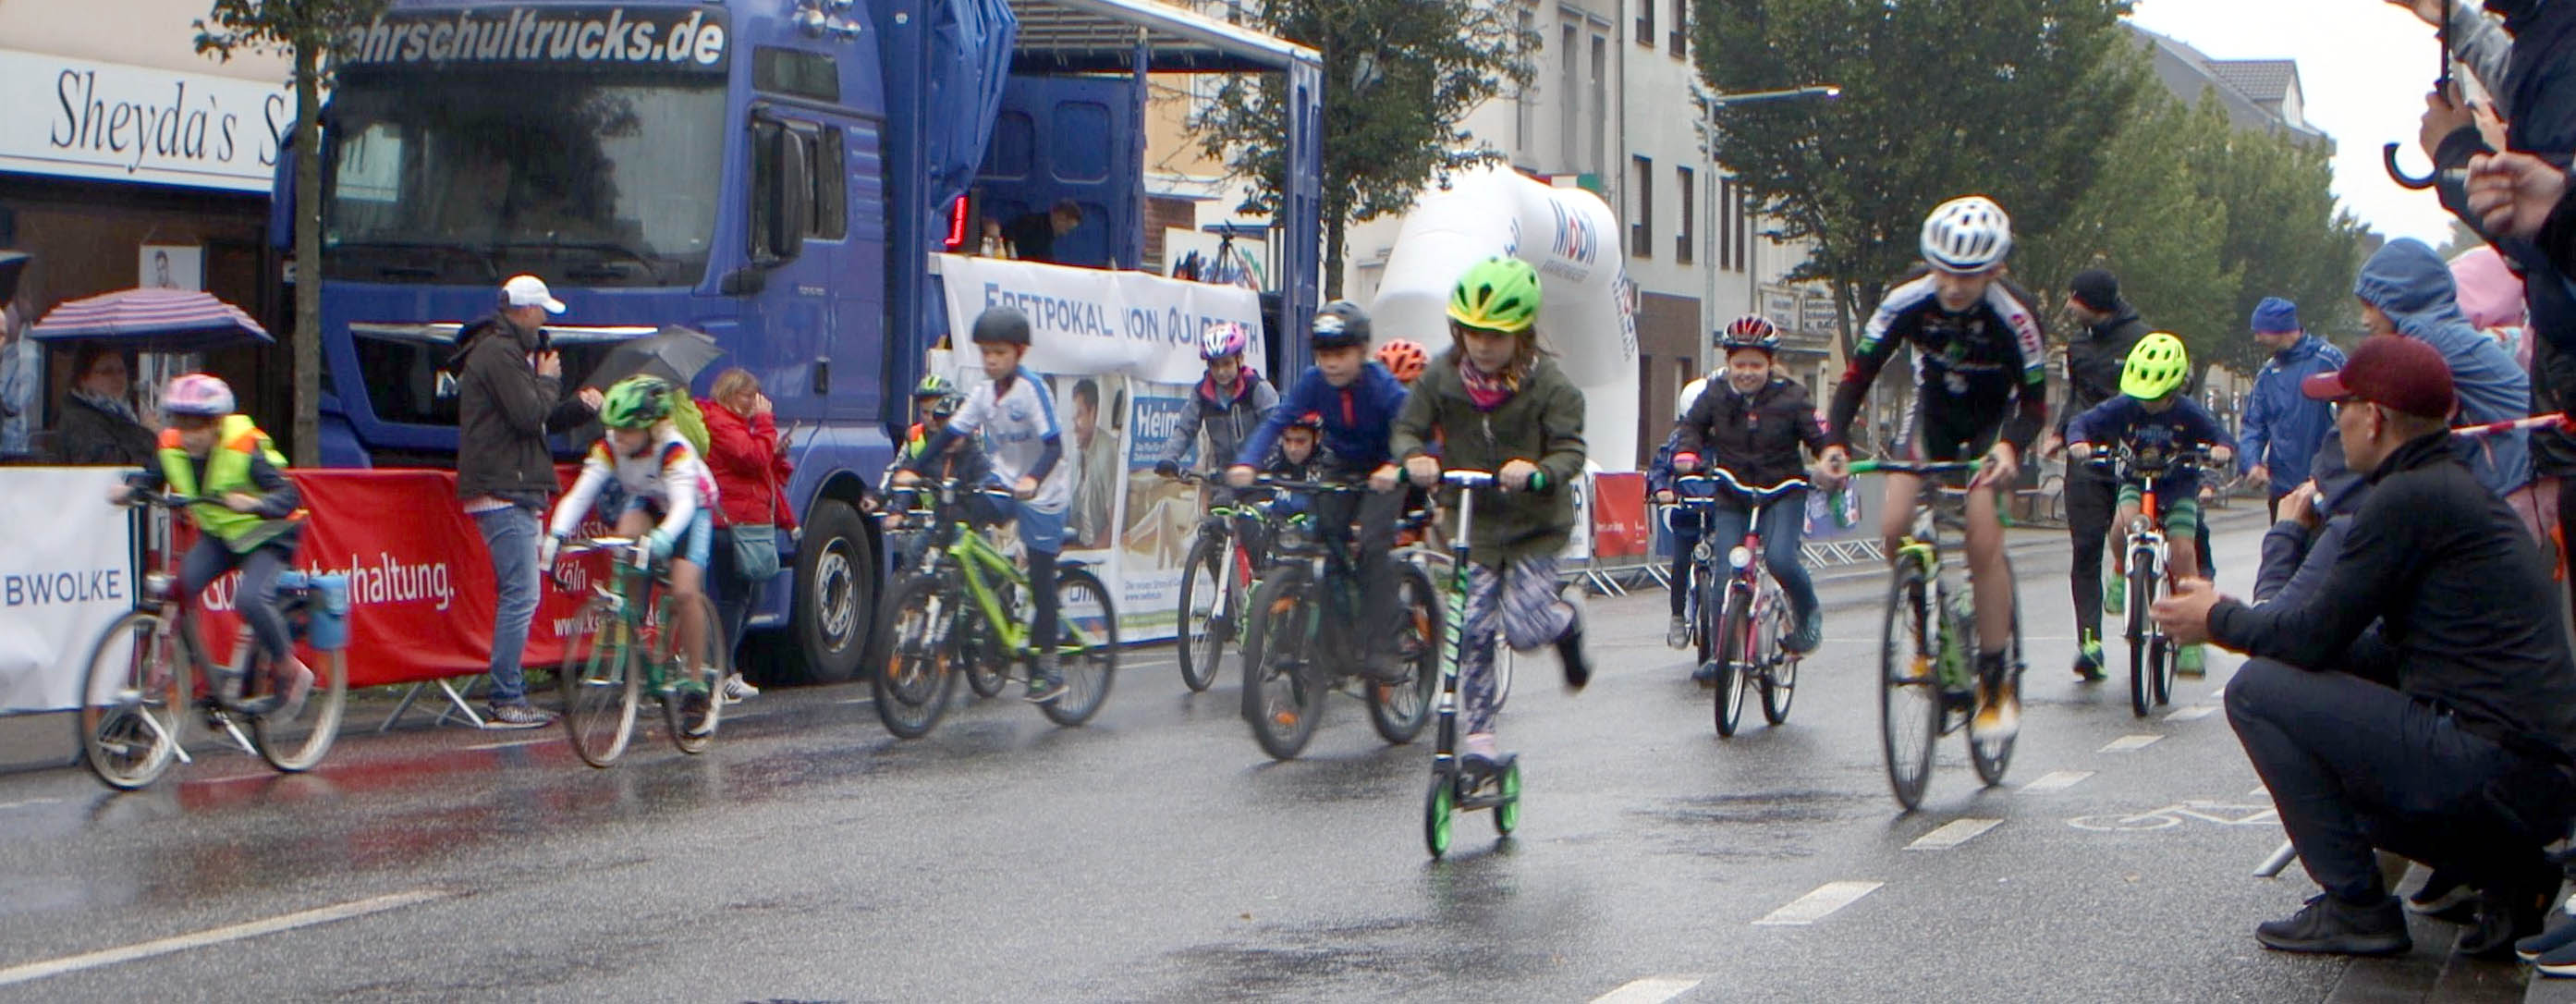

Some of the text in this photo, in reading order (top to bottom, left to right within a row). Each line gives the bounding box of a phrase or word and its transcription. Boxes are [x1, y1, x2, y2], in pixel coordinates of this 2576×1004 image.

[338, 8, 725, 64] ahrschultrucks.de
[259, 93, 285, 166] S
[1548, 198, 1597, 265] Mobil
[1120, 308, 1160, 341] VON
[554, 559, 586, 593] Köln
